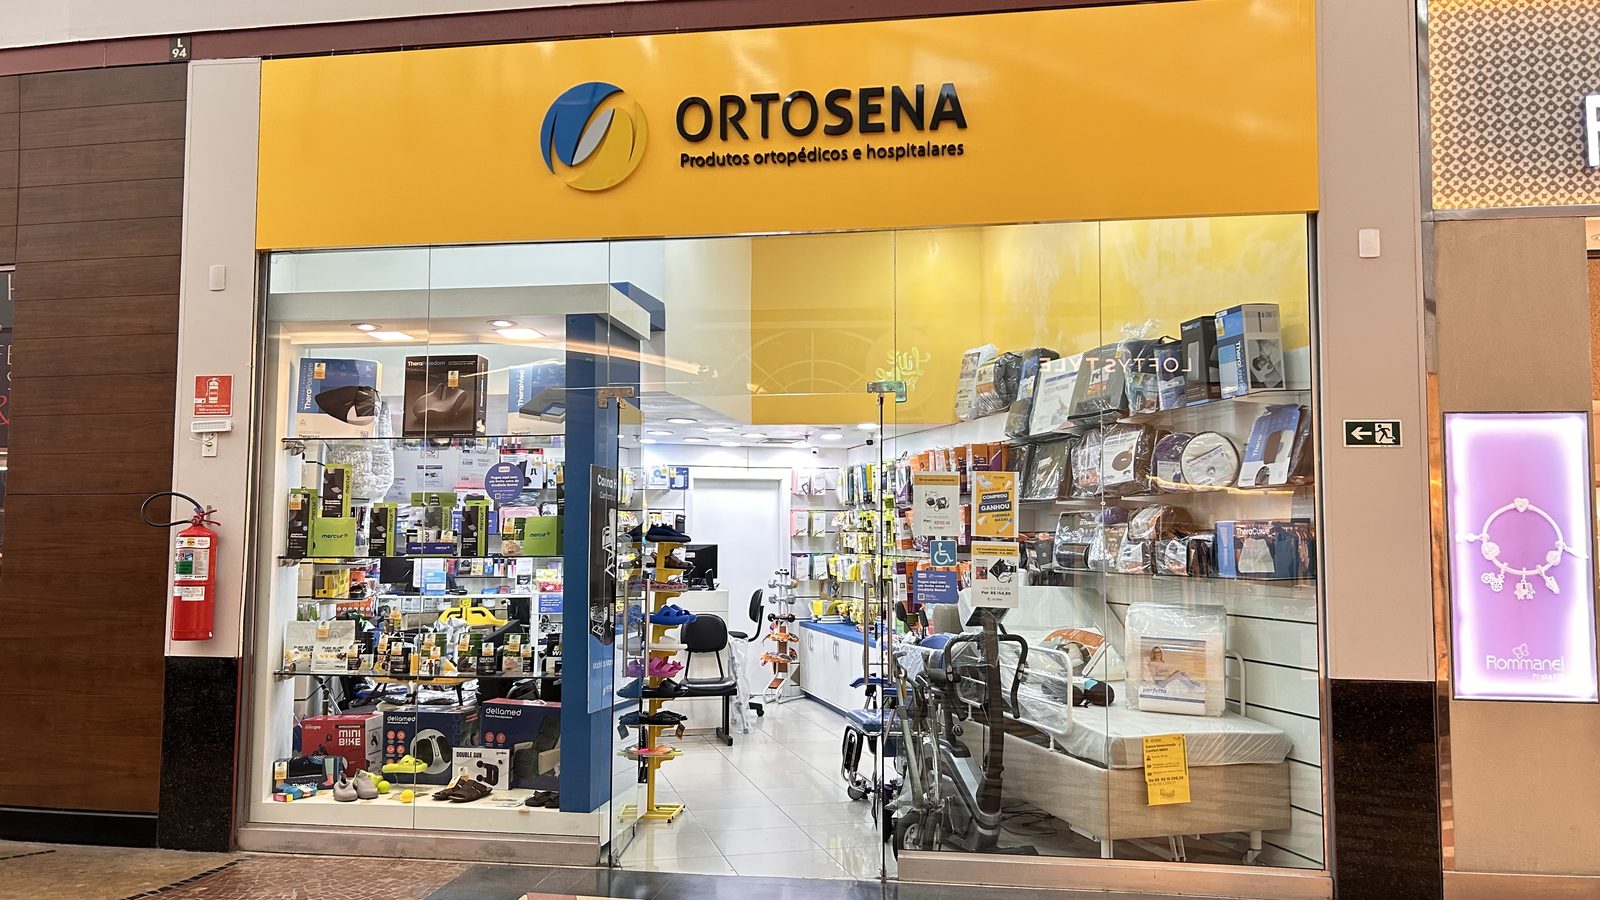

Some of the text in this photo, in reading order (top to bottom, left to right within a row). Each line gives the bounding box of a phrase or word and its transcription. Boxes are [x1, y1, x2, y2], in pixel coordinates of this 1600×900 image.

[177, 38, 184, 48] L
[172, 48, 187, 58] 94
[676, 83, 967, 142] ORTOSENA
[680, 141, 964, 168] Produtos ortopédicos e hospitalares
[1486, 655, 1564, 672] Rommanel
[486, 707, 522, 716] dellamed
[339, 730, 361, 738] MINI
